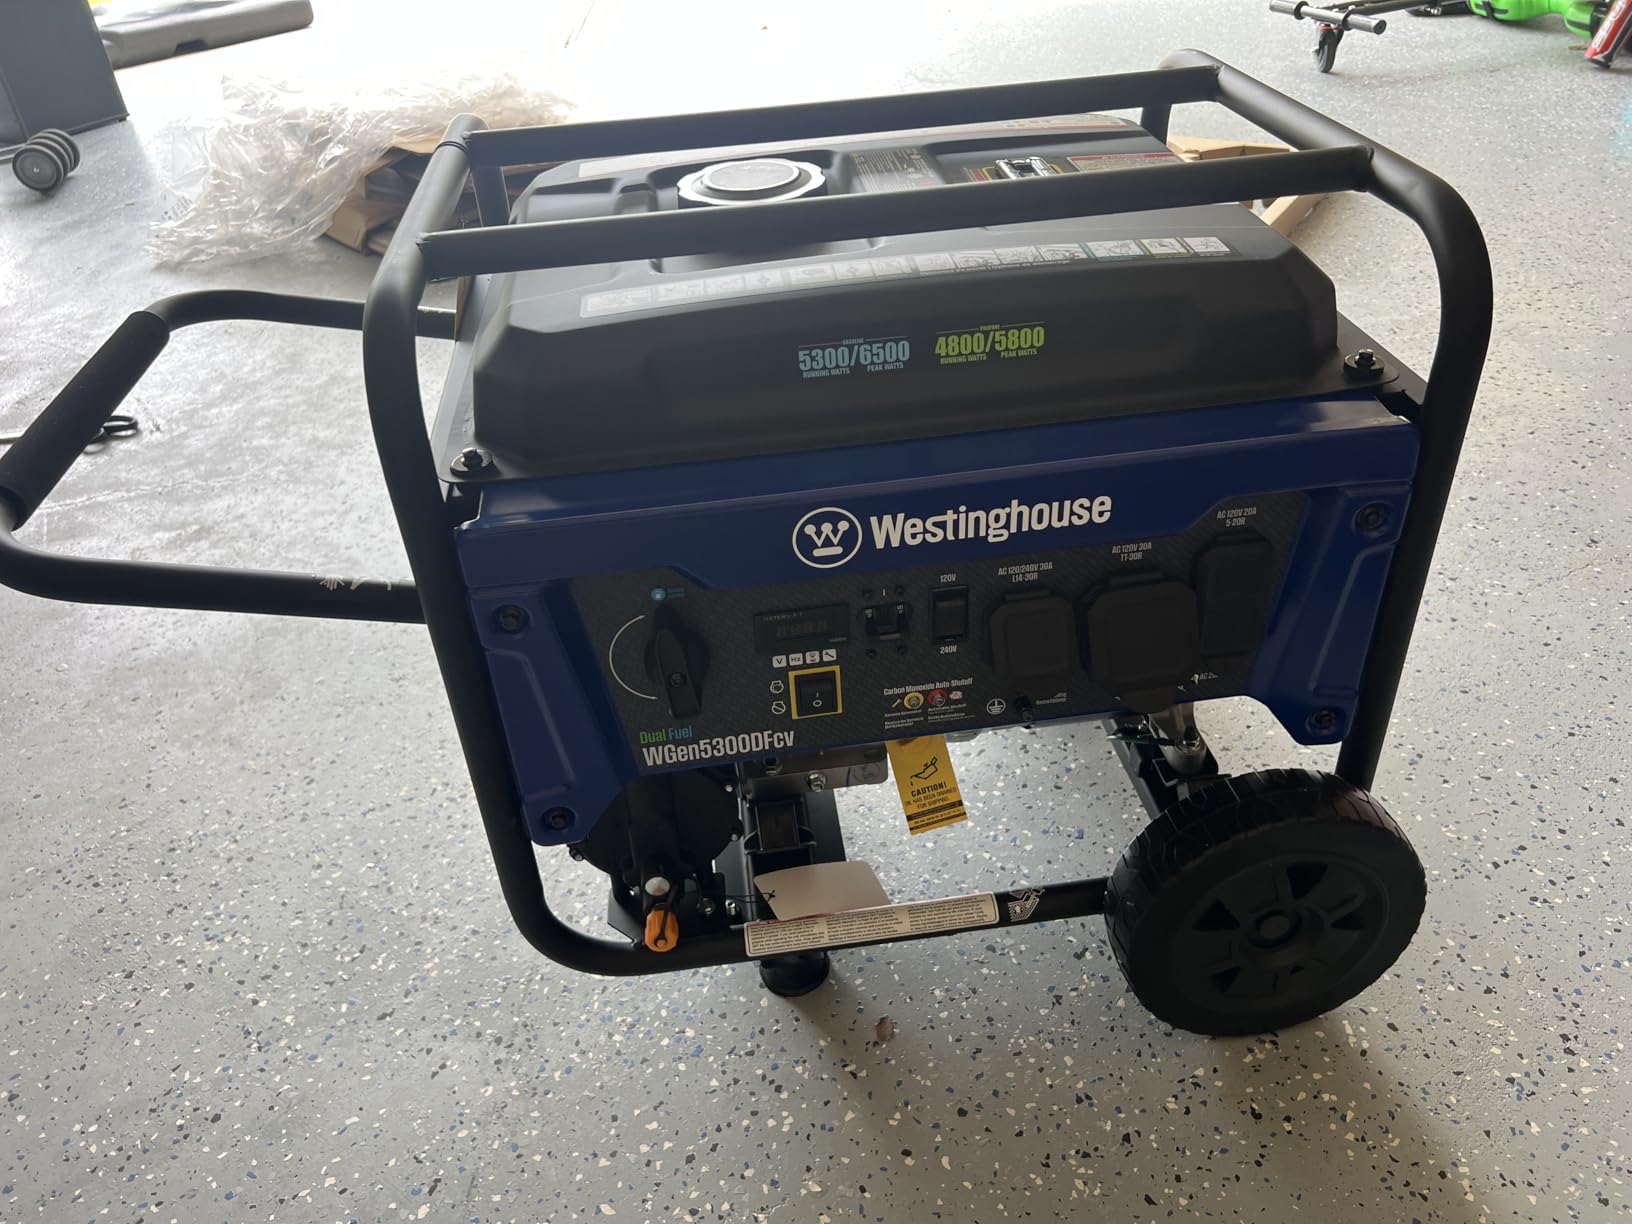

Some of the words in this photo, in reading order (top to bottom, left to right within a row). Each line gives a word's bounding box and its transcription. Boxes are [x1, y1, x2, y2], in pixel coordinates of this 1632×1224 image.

[934, 326, 1045, 357] 4800/5800
[799, 340, 911, 371] 5300/6500
[967, 353, 988, 362] WATTS
[1001, 350, 1018, 359] PEAK
[1018, 347, 1038, 357] WATTS
[830, 367, 851, 376] WATTS
[867, 364, 884, 372] PEAK
[884, 361, 904, 370] WATTS
[1216, 510, 1227, 520] AC
[1226, 508, 1243, 518] 120V
[1243, 506, 1257, 516] 20A
[870, 495, 1112, 550] Westinghouse
[1225, 516, 1246, 528] 5-20R
[1111, 545, 1122, 554] AC
[1121, 543, 1139, 553] 120V
[1138, 541, 1152, 551] 30A
[1120, 551, 1143, 562] TT-30R
[998, 567, 1008, 576] AC
[1039, 561, 1053, 571] 30A
[940, 573, 957, 583] 120V
[1011, 571, 1039, 583] L14-30R
[940, 645, 958, 655] 240V
[883, 686, 906, 696] Carbon
[905, 682, 935, 693] Monoxide
[935, 680, 950, 690] Auto
[950, 677, 974, 688] Shutoff
[640, 729, 667, 745] Dual
[668, 725, 693, 740] Fuel
[642, 731, 795, 767] WGen5300DFcv
[911, 781, 947, 798] CAUTION!
[912, 796, 923, 804] HAS
[923, 792, 937, 801] BEEN
[917, 802, 928, 810] FOR
